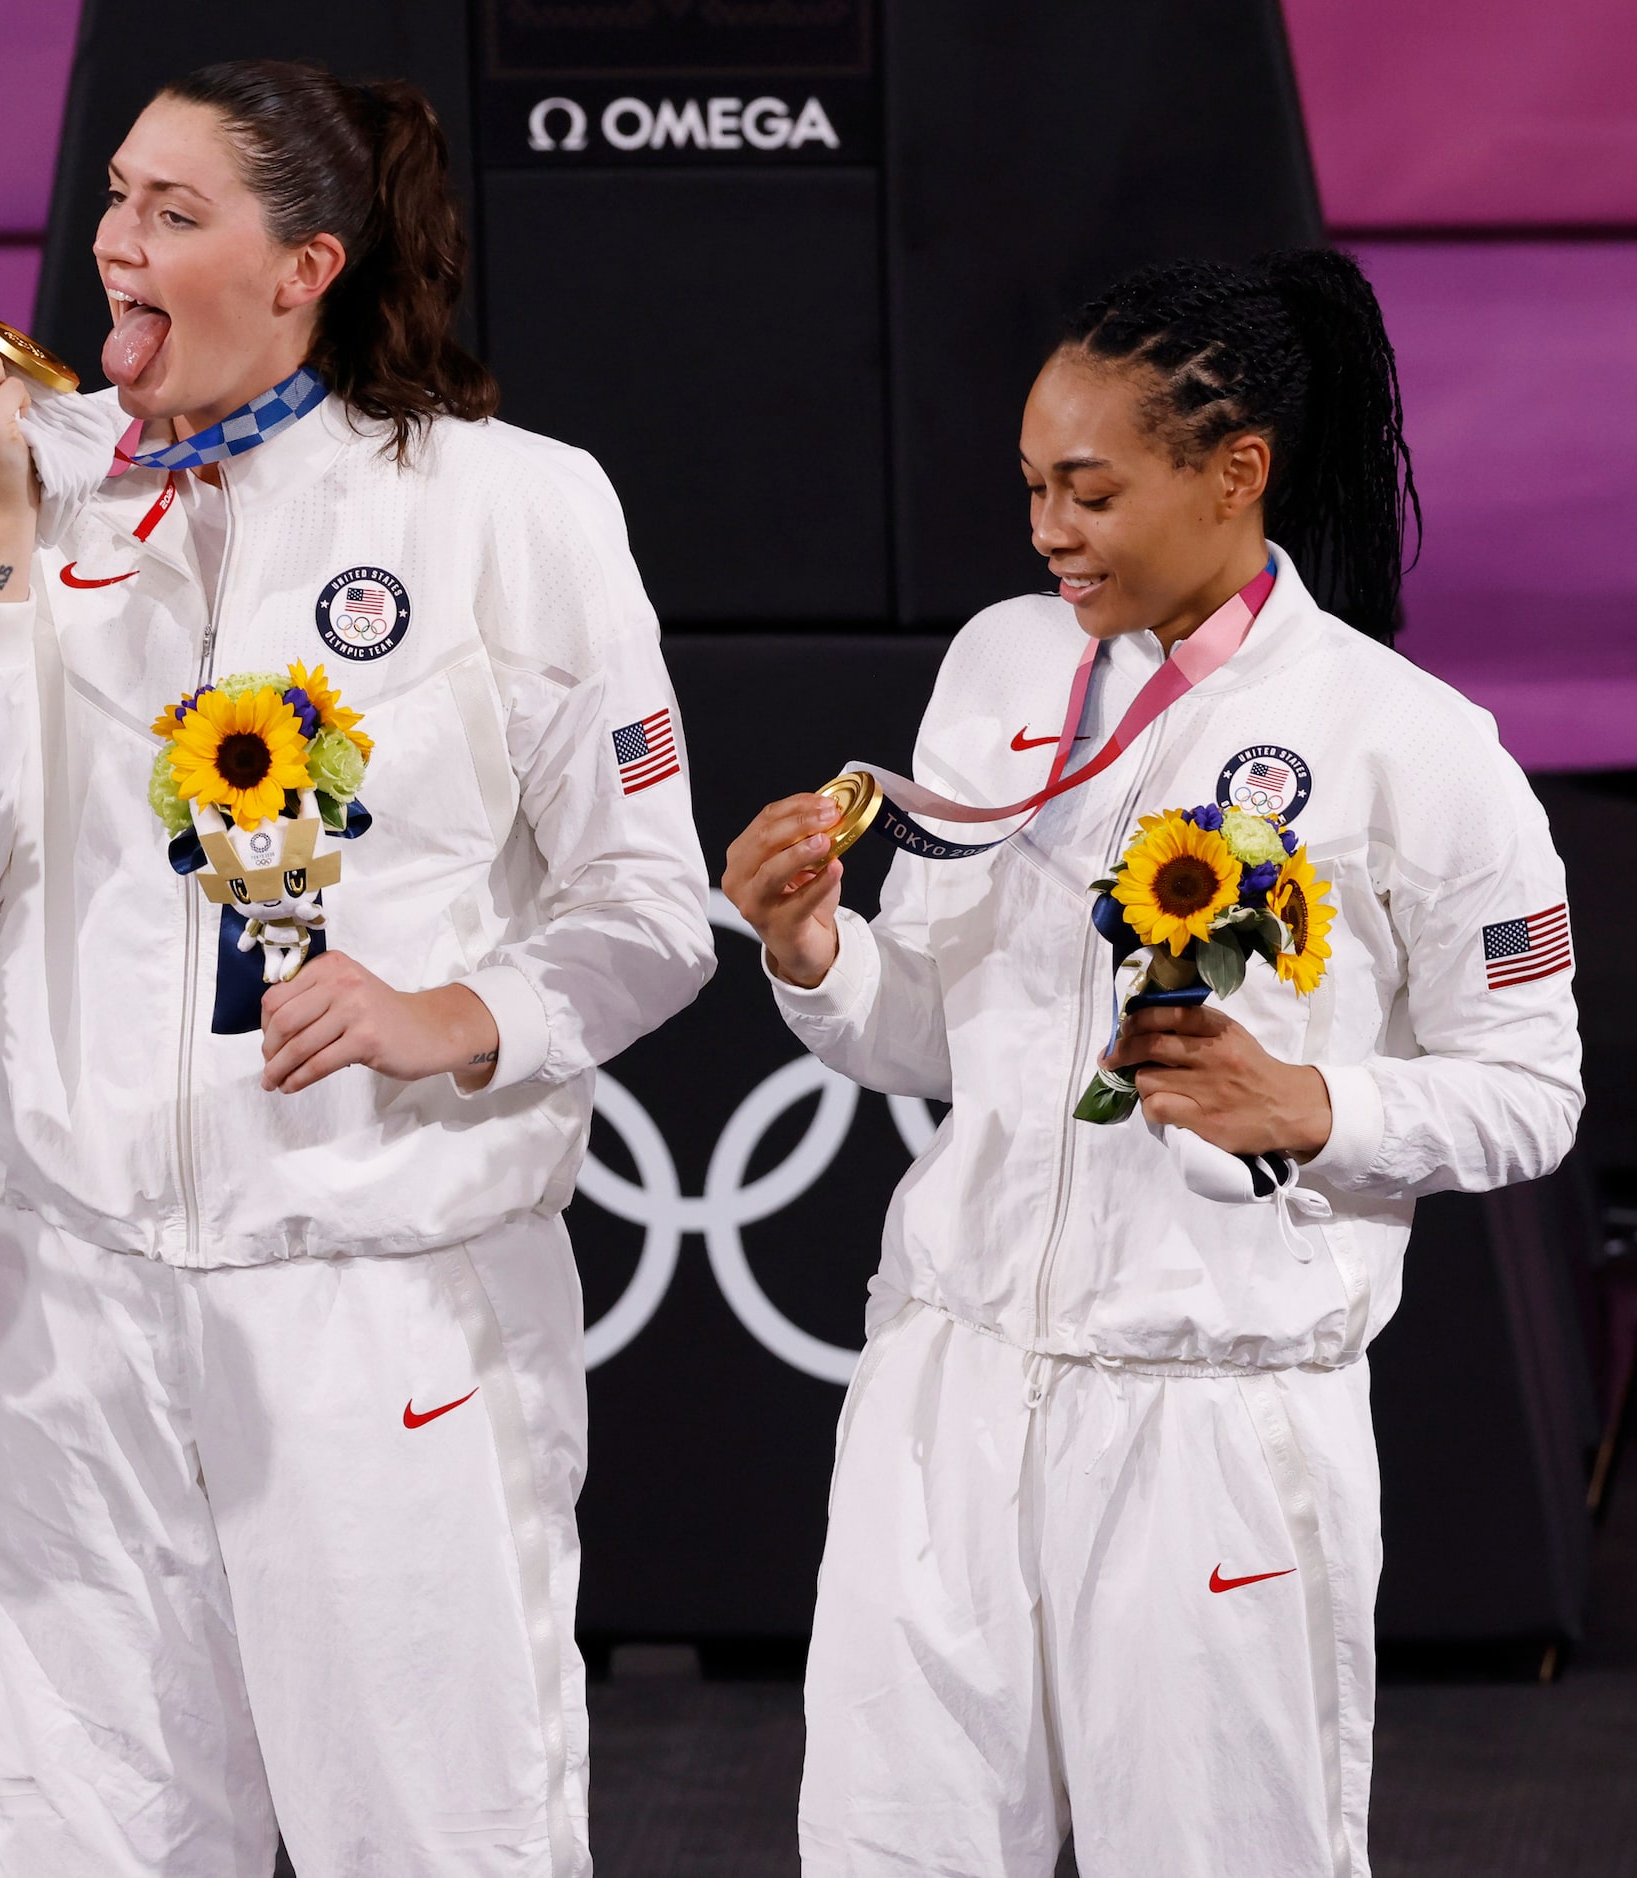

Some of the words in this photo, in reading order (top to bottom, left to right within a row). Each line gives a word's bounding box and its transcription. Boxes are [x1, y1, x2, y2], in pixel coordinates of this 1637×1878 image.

[601, 97, 841, 151] OMEGA
[331, 569, 367, 591] UNITED
[371, 570, 403, 597] STATES
[324, 630, 364, 657] OLYMPIC
[368, 638, 394, 657] TEAM
[1237, 747, 1277, 763] UNITED
[1279, 750, 1307, 778] STATES
[884, 813, 946, 856] TOKYO
